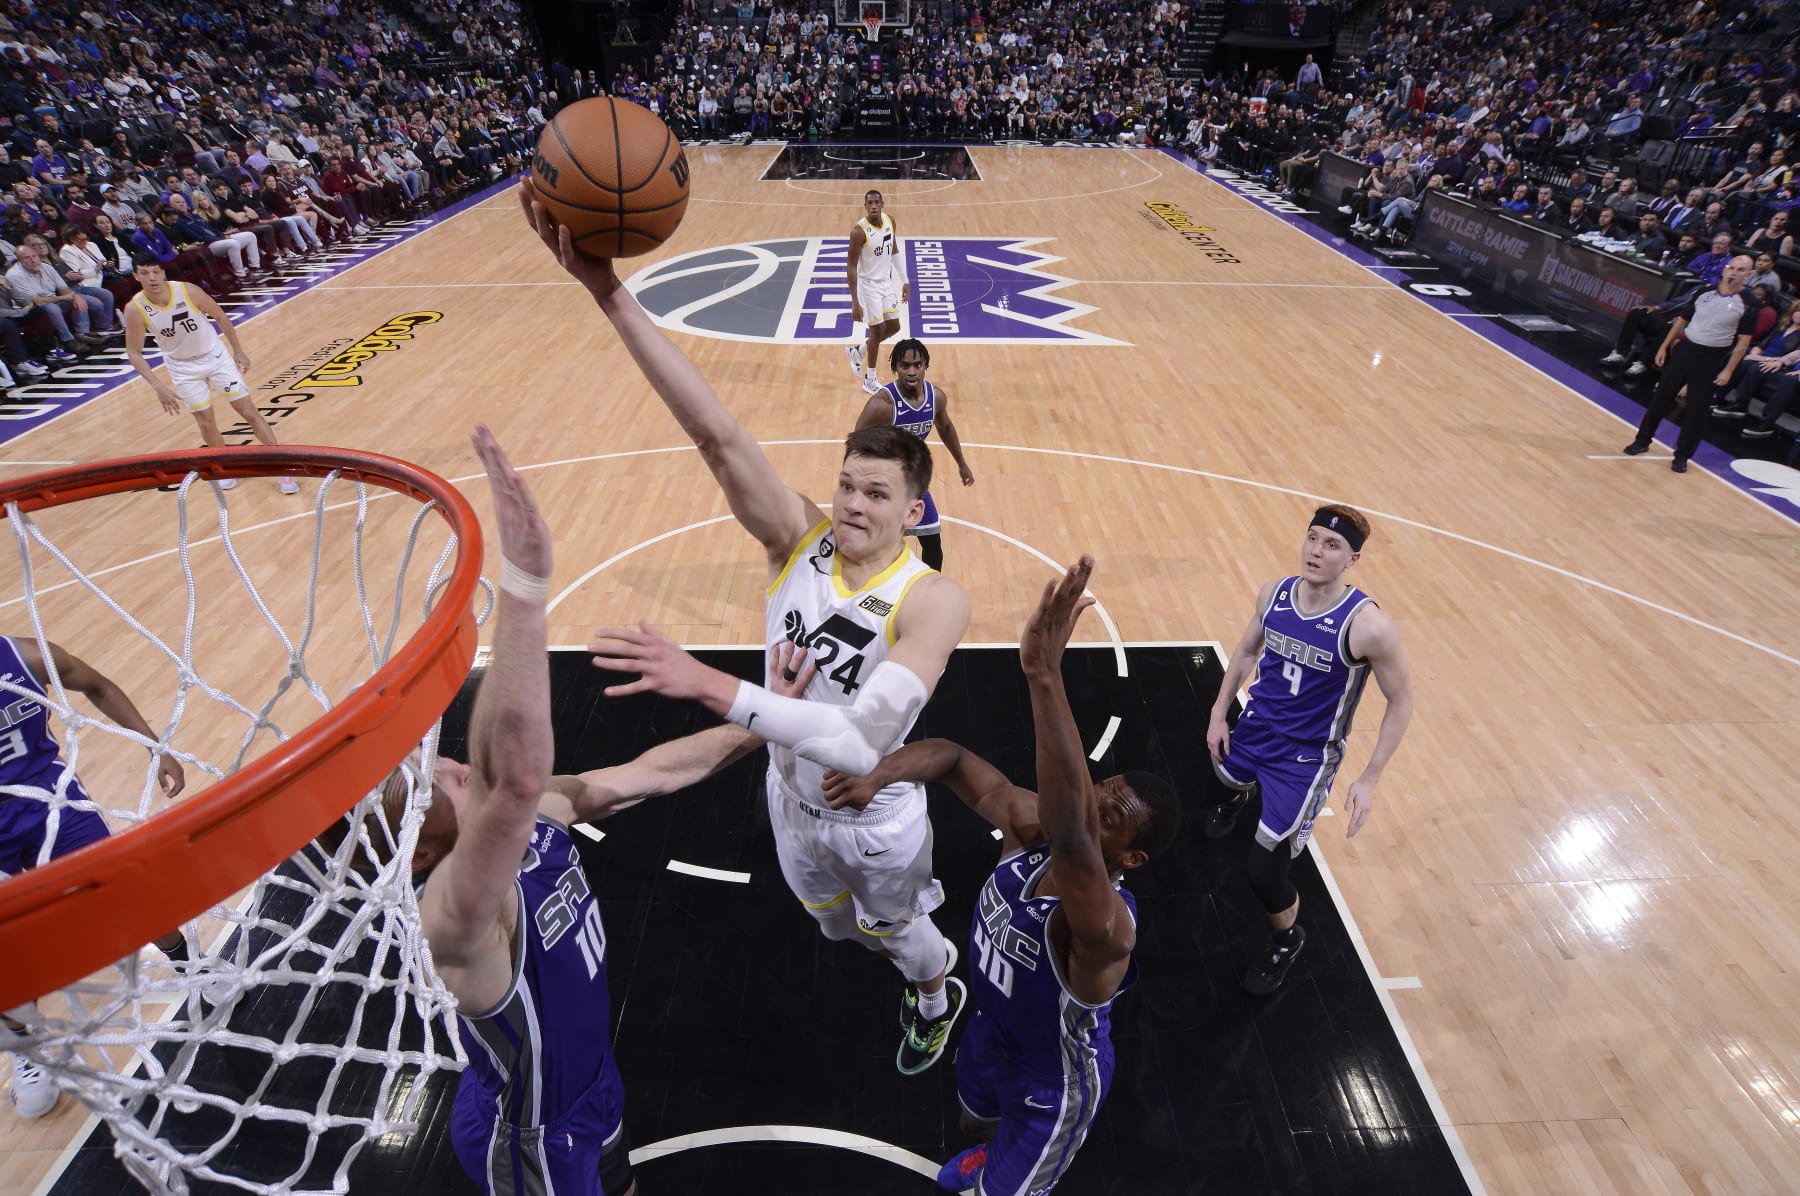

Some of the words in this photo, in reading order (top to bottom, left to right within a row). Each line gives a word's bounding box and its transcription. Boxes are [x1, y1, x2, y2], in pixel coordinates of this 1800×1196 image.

[1224, 179, 1321, 213] dialpad
[1180, 231, 1241, 264] CENTER
[1429, 207, 1482, 241] CATTLES
[1483, 226, 1530, 260] RAMIE
[914, 241, 960, 334] SACRAMENTO
[1555, 263, 1602, 298] SACTOWN
[1598, 280, 1644, 314] SPORTS
[180, 318, 198, 334] 16
[303, 337, 354, 362] Credit
[0, 332, 165, 420] ROUD
[257, 363, 311, 390] Union
[860, 596, 877, 608] 5
[1279, 590, 1288, 601] 6
[1315, 623, 1337, 635] dialpad
[812, 636, 865, 696] 24
[1264, 627, 1333, 673] SAC
[1282, 660, 1303, 697] 9
[799, 800, 821, 820] UTAH
[539, 826, 555, 854] ialpad
[1028, 853, 1043, 865] 6
[979, 873, 1041, 972] SAC
[575, 898, 607, 983] 10
[974, 918, 1014, 999] 40
